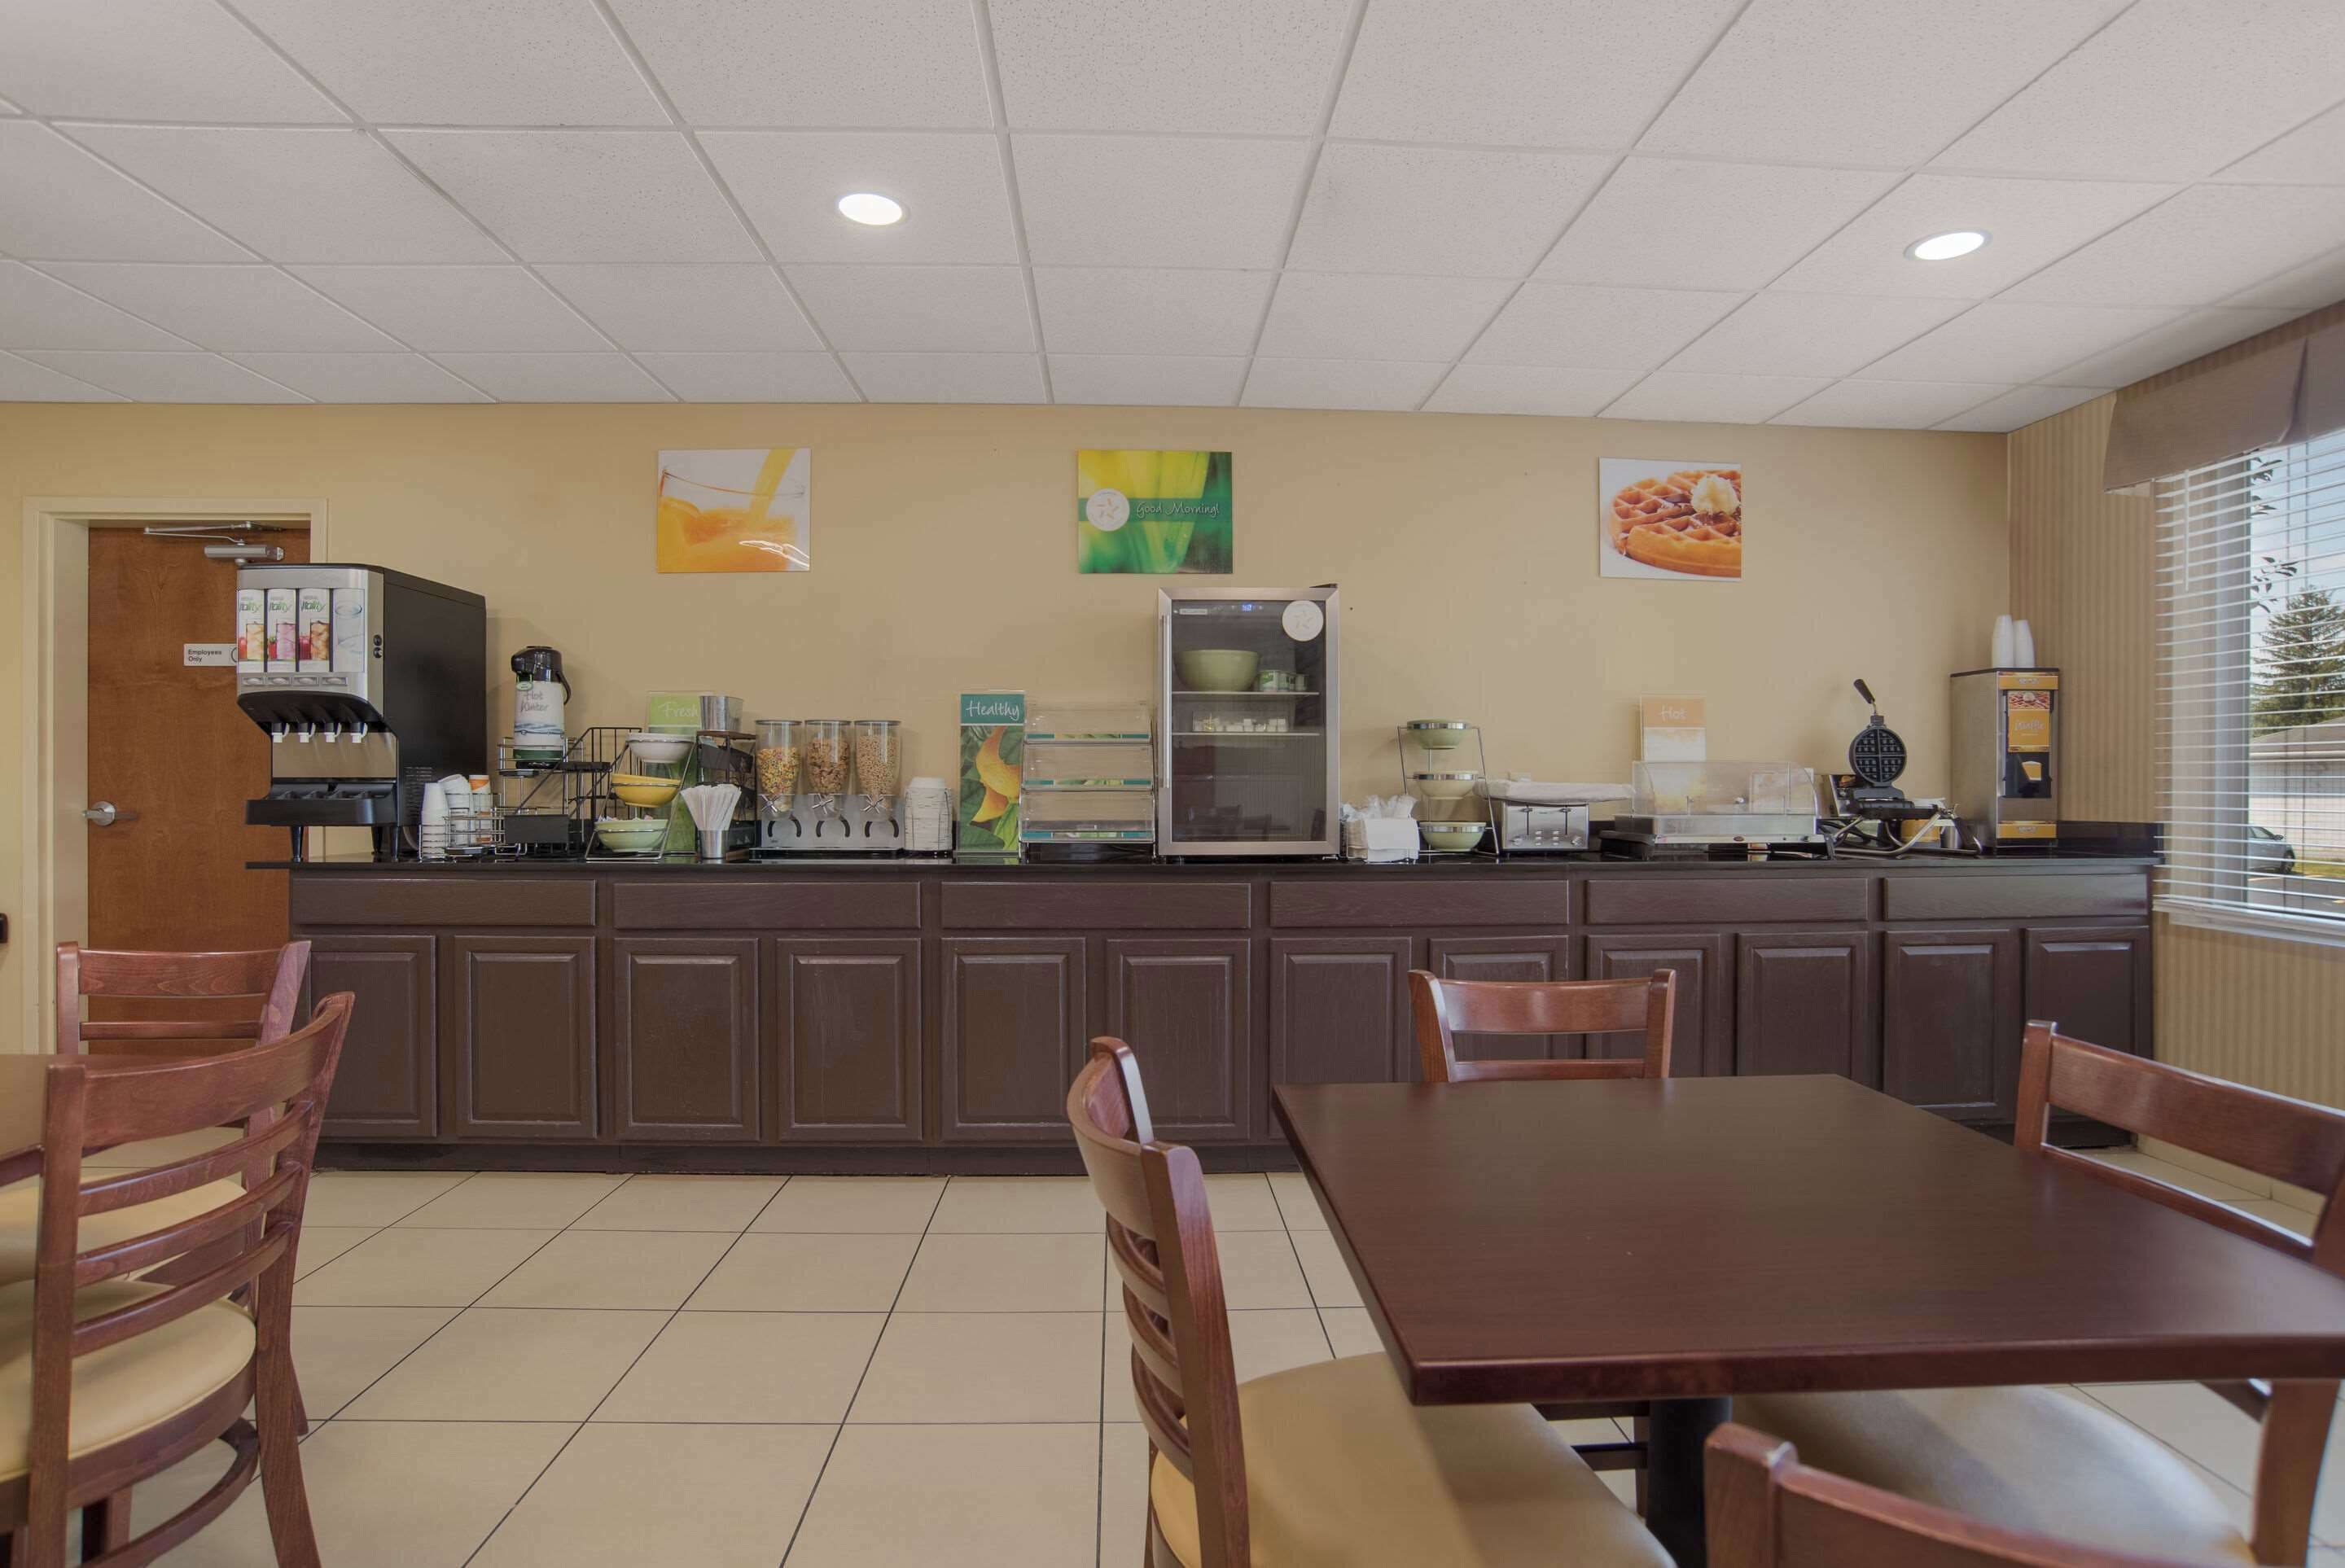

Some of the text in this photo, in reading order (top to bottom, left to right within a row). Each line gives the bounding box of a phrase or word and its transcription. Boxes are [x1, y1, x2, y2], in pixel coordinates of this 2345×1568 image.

[1137, 501, 1220, 519] Good Morning!
[523, 690, 544, 700] Hot
[657, 701, 699, 718] Fresh
[966, 700, 1019, 721] Healthy
[1656, 704, 1686, 723] Hot
